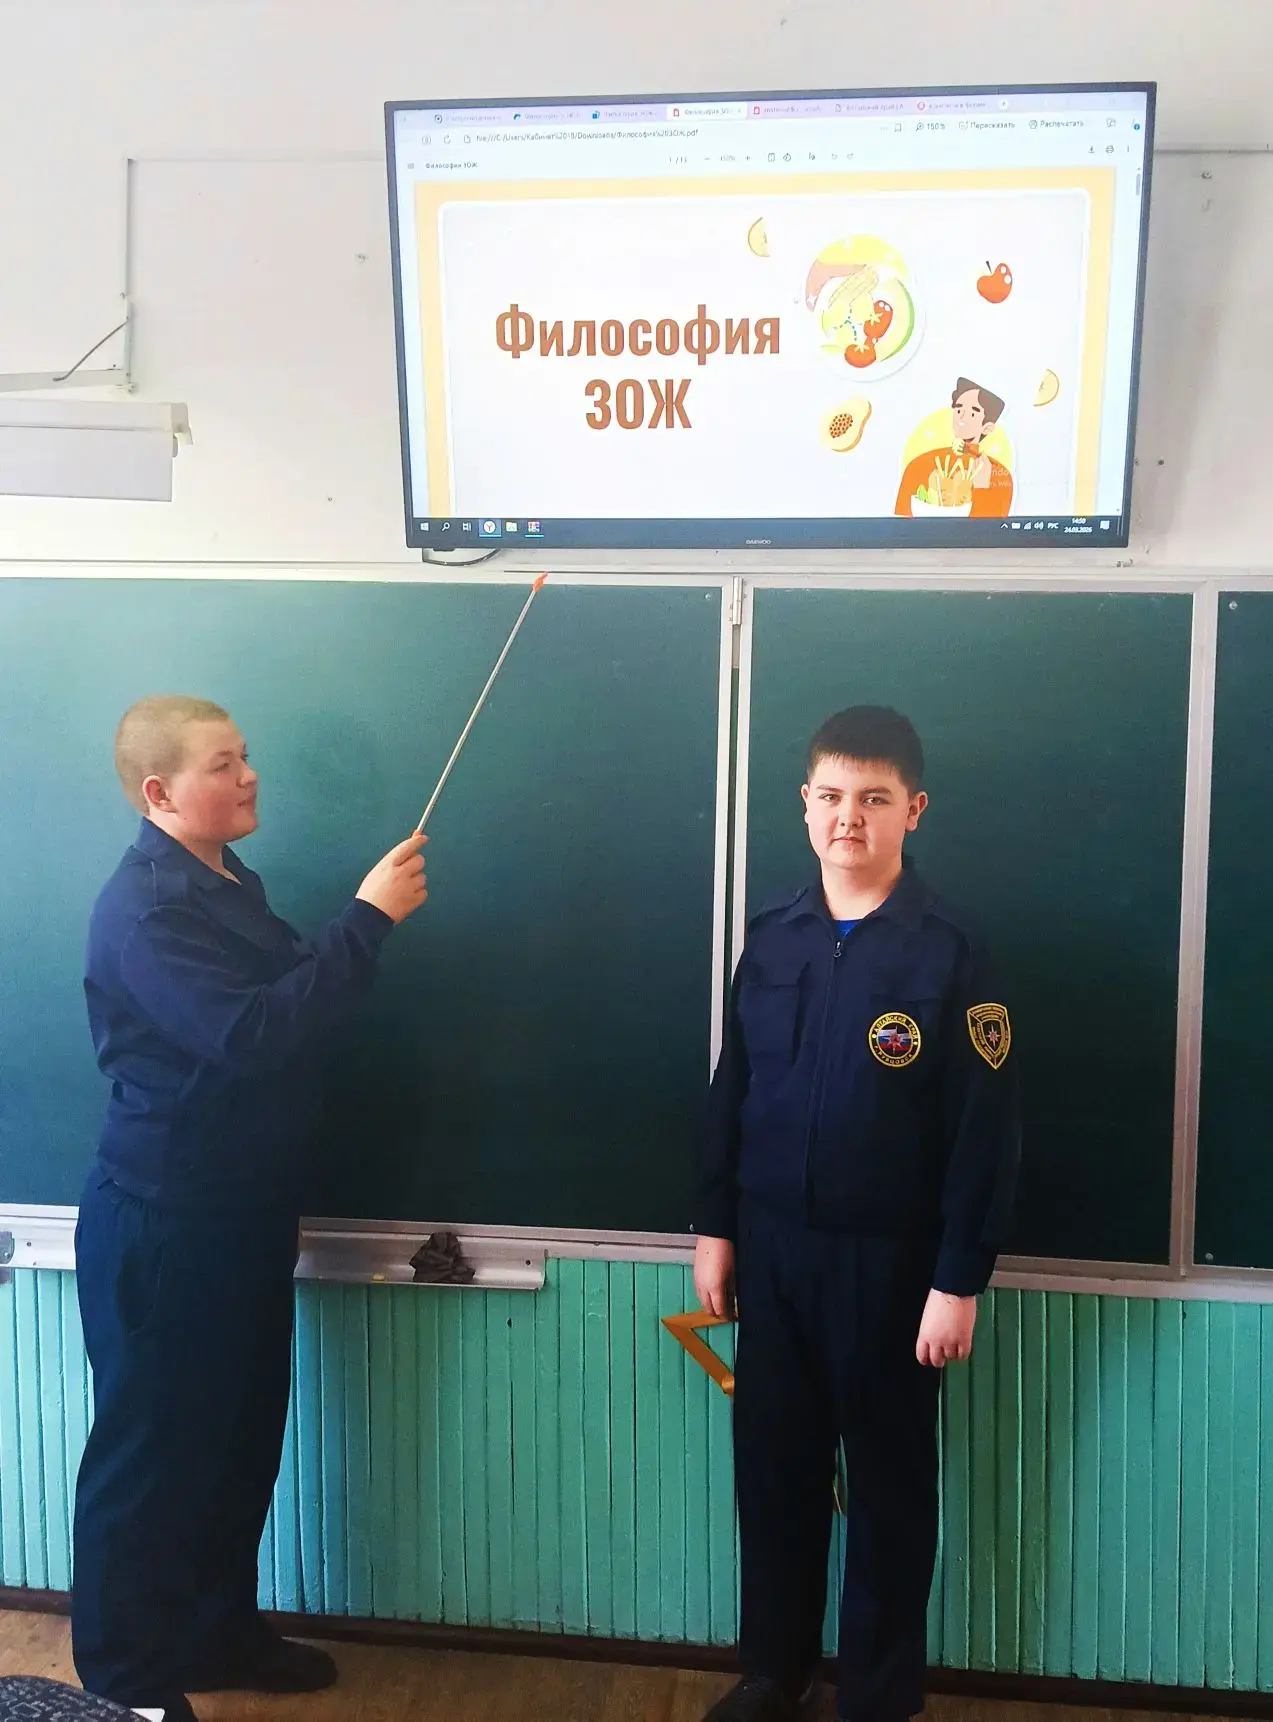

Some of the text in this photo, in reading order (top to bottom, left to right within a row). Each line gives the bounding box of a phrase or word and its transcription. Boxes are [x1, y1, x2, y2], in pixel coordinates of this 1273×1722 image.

[970, 121, 1016, 130] Пересказать
[1040, 120, 1085, 128] Распечатать
[425, 163, 463, 171] Философия
[495, 303, 780, 366] Философия
[584, 378, 692, 430] ЗОЖ
